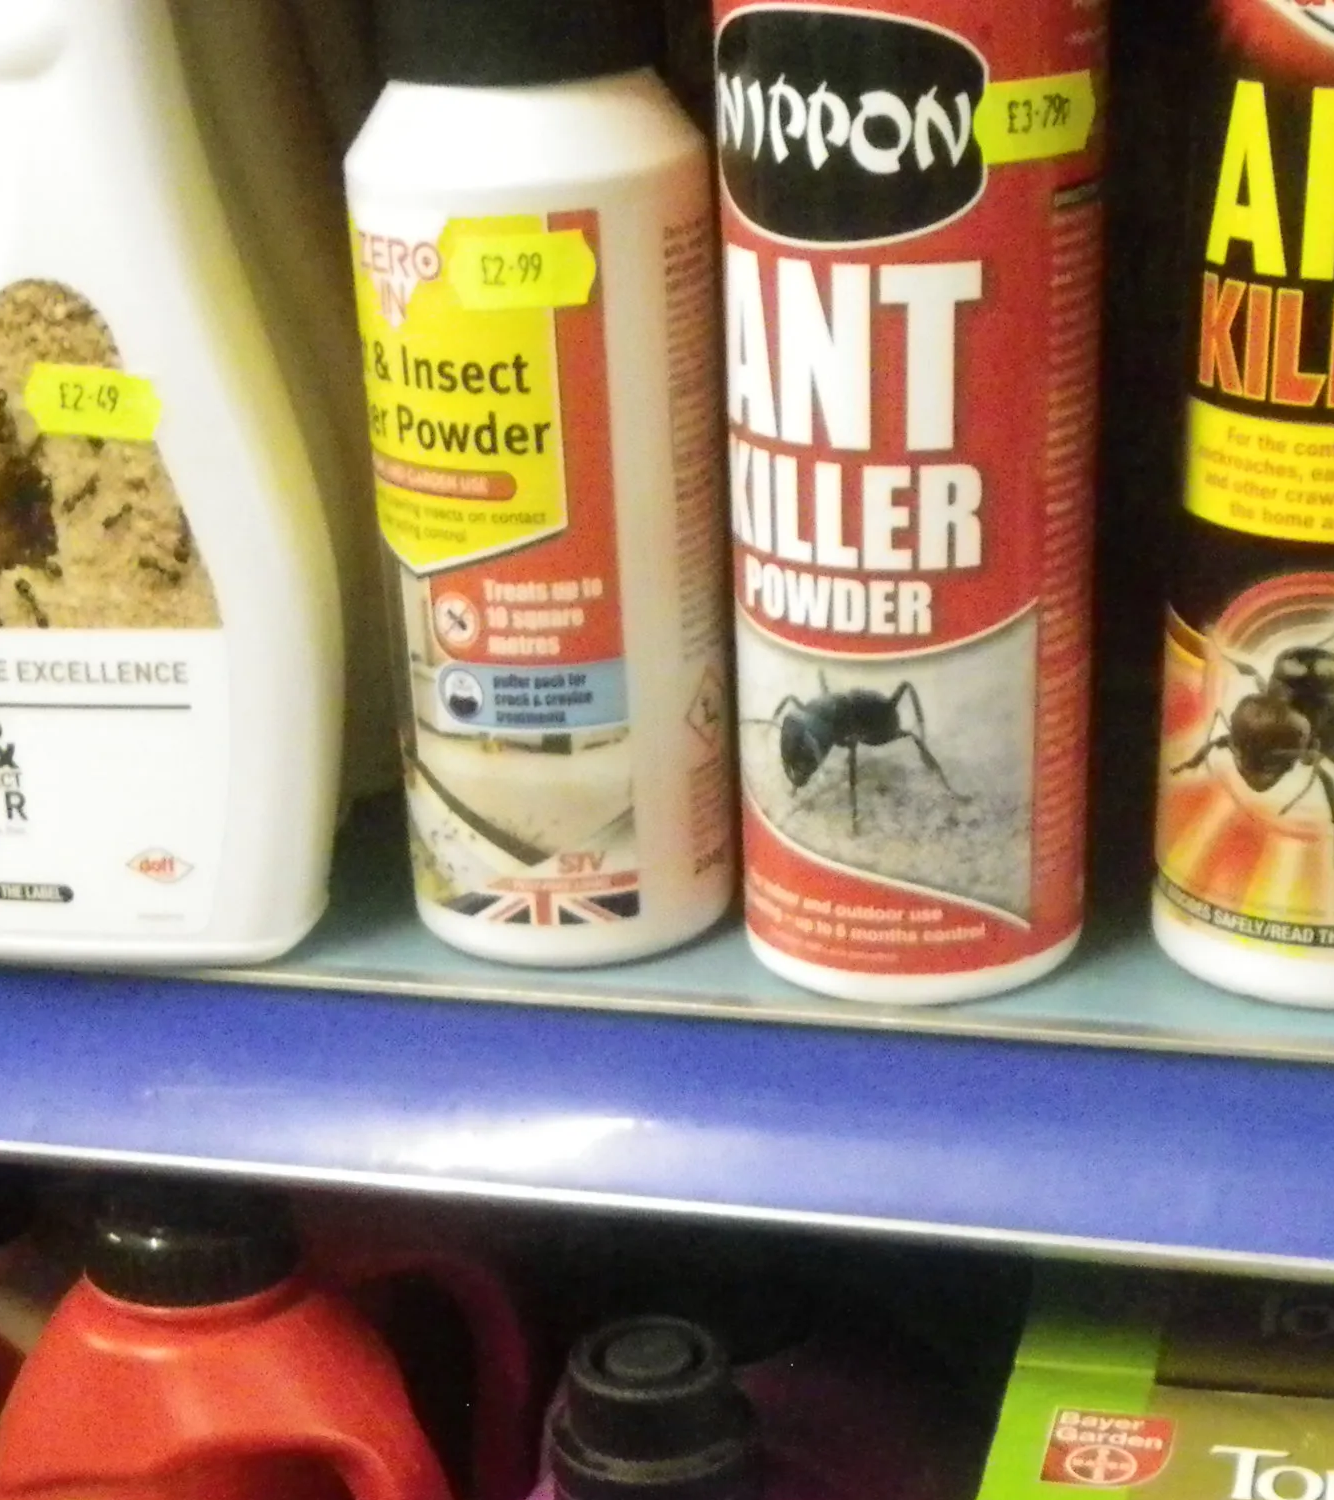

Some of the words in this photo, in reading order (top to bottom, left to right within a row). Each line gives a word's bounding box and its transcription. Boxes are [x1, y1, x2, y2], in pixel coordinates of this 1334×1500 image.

[717, 73, 969, 174] NIPPON
[374, 341, 393, 383] &
[401, 345, 532, 394] Insect
[725, 242, 983, 452] ANT
[396, 403, 552, 456] Powder
[731, 434, 984, 573] KILLER
[744, 554, 933, 636] POWDER
[17, 660, 189, 686] EXCELLENCE
[1055, 1425, 1163, 1452] Garden
[1058, 1410, 1146, 1432] Bayer
